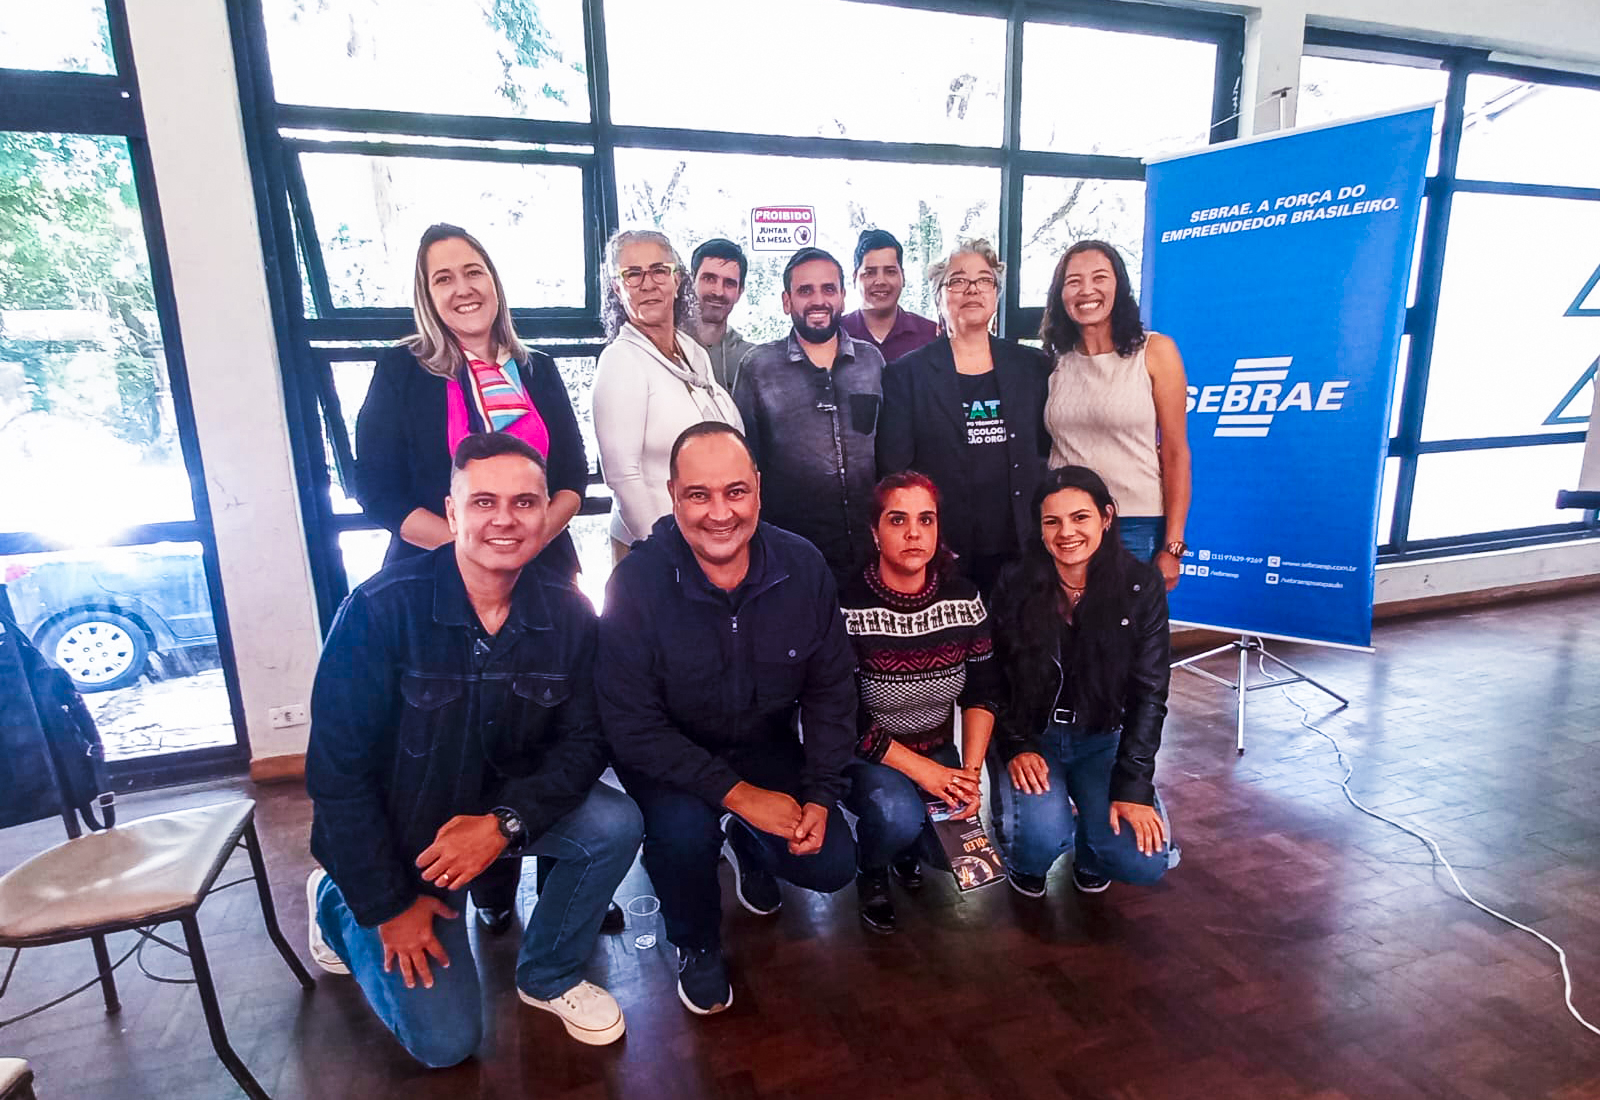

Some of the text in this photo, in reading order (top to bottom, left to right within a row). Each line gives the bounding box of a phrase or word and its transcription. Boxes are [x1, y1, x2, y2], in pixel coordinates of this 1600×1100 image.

[756, 211, 811, 220] PROIBIDO
[1161, 197, 1399, 243] EMPREENDEDOR BRASILEIRO.
[1190, 184, 1366, 223] SEBRAE. A FORÇA DO
[1185, 380, 1350, 414] SEBRAE
